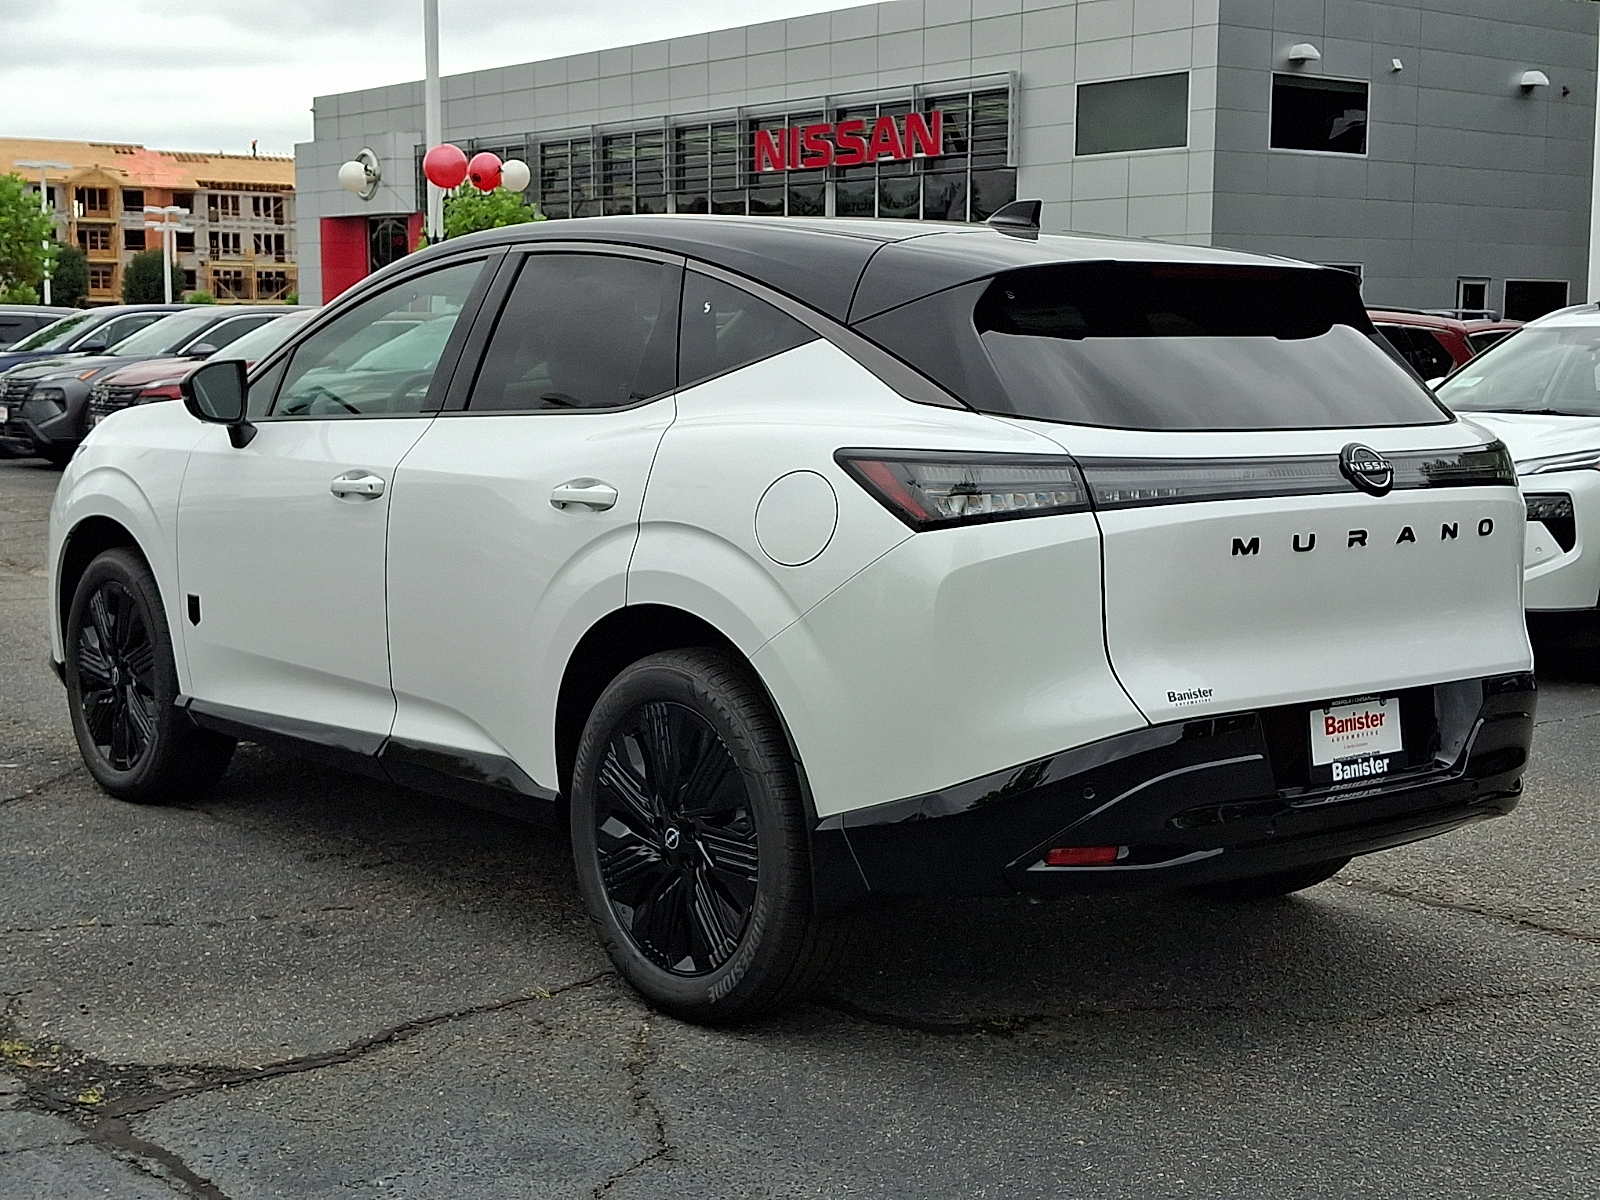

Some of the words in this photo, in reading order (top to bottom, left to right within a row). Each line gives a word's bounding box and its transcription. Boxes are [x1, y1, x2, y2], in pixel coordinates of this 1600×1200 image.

[755, 110, 943, 172] NISSAN
[1350, 461, 1393, 472] NISSAN
[1231, 518, 1494, 556] MURANO
[1167, 687, 1213, 703] Banister
[1324, 710, 1386, 736] Banister
[1332, 757, 1390, 781] Banister
